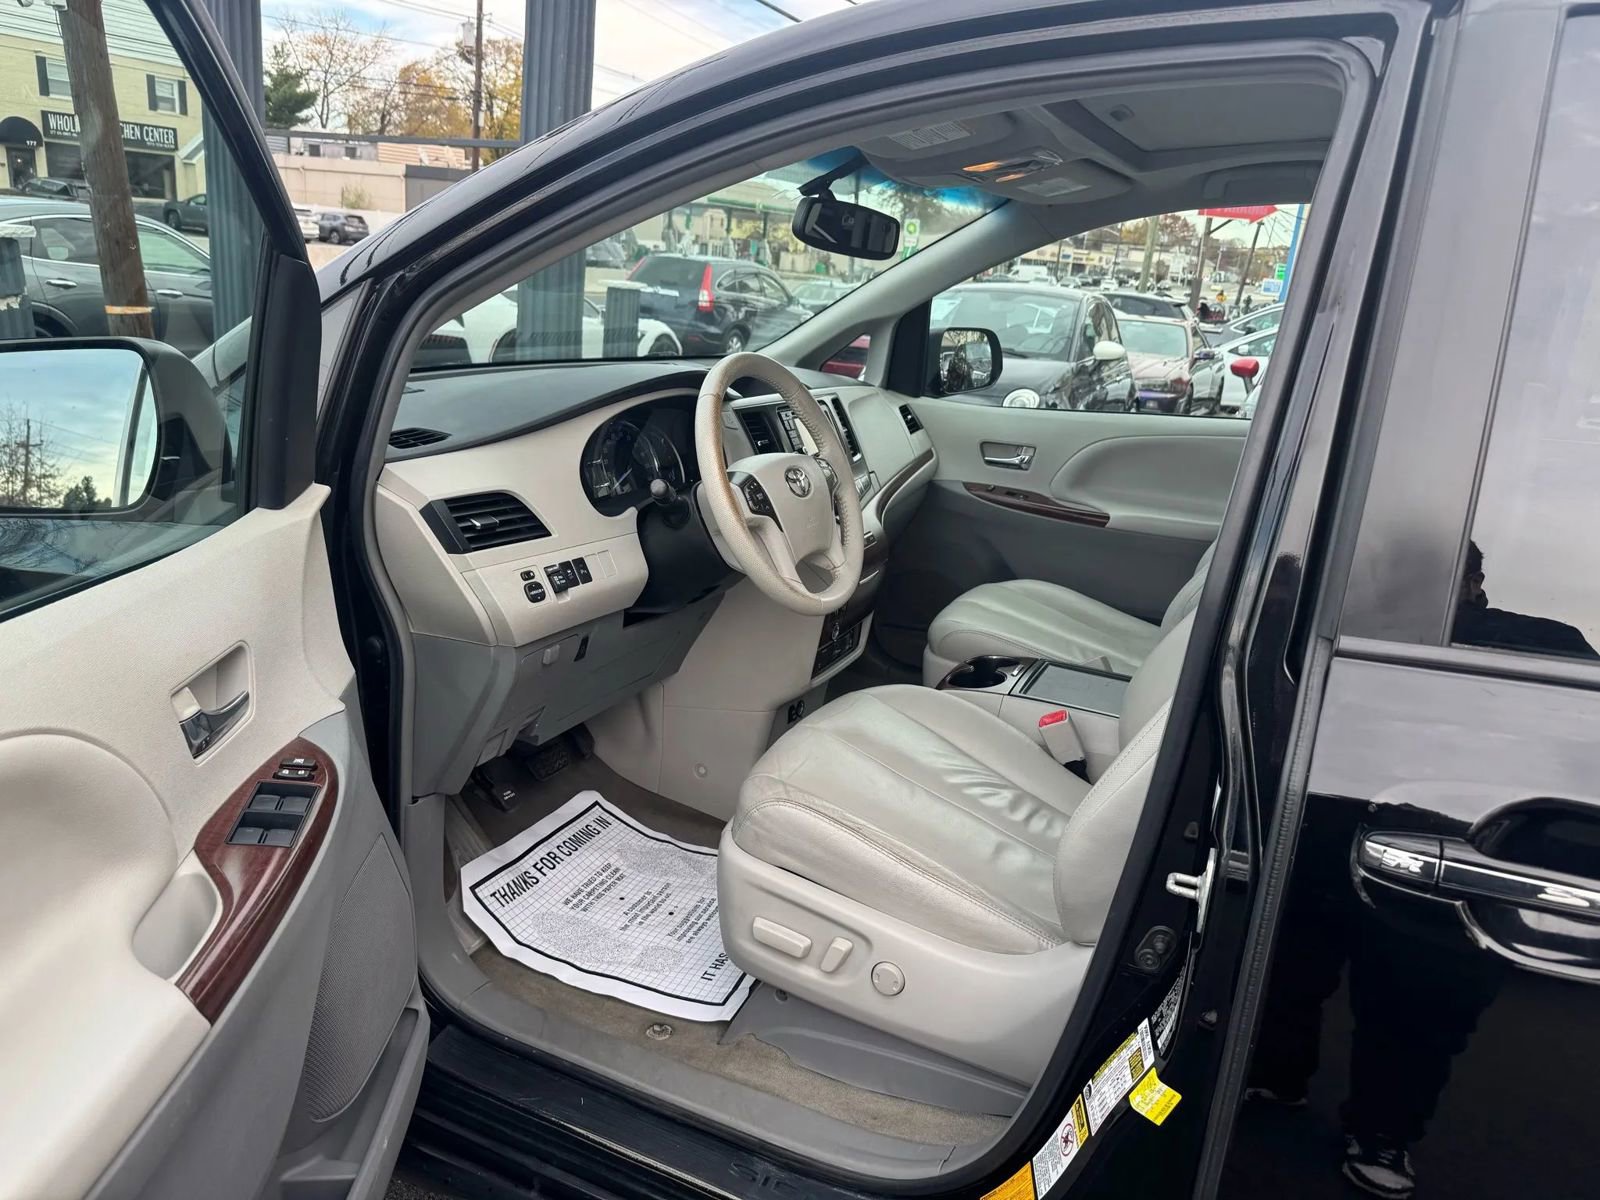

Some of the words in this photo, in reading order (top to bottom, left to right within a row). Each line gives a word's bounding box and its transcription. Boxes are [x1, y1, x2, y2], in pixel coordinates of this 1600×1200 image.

[143, 125, 175, 145] CENTER
[490, 870, 540, 908] THANKS
[532, 851, 564, 877] FOR
[556, 824, 601, 857] COMING
[593, 815, 612, 830] IN
[562, 897, 573, 906] WE
[570, 888, 584, 899] HAVE
[581, 876, 597, 889] TRIED
[569, 898, 585, 910] YOUR
[605, 867, 620, 880] CLEAN
[602, 880, 618, 893] PAPER
[700, 971, 716, 981] IT
[709, 953, 728, 970] HAS
